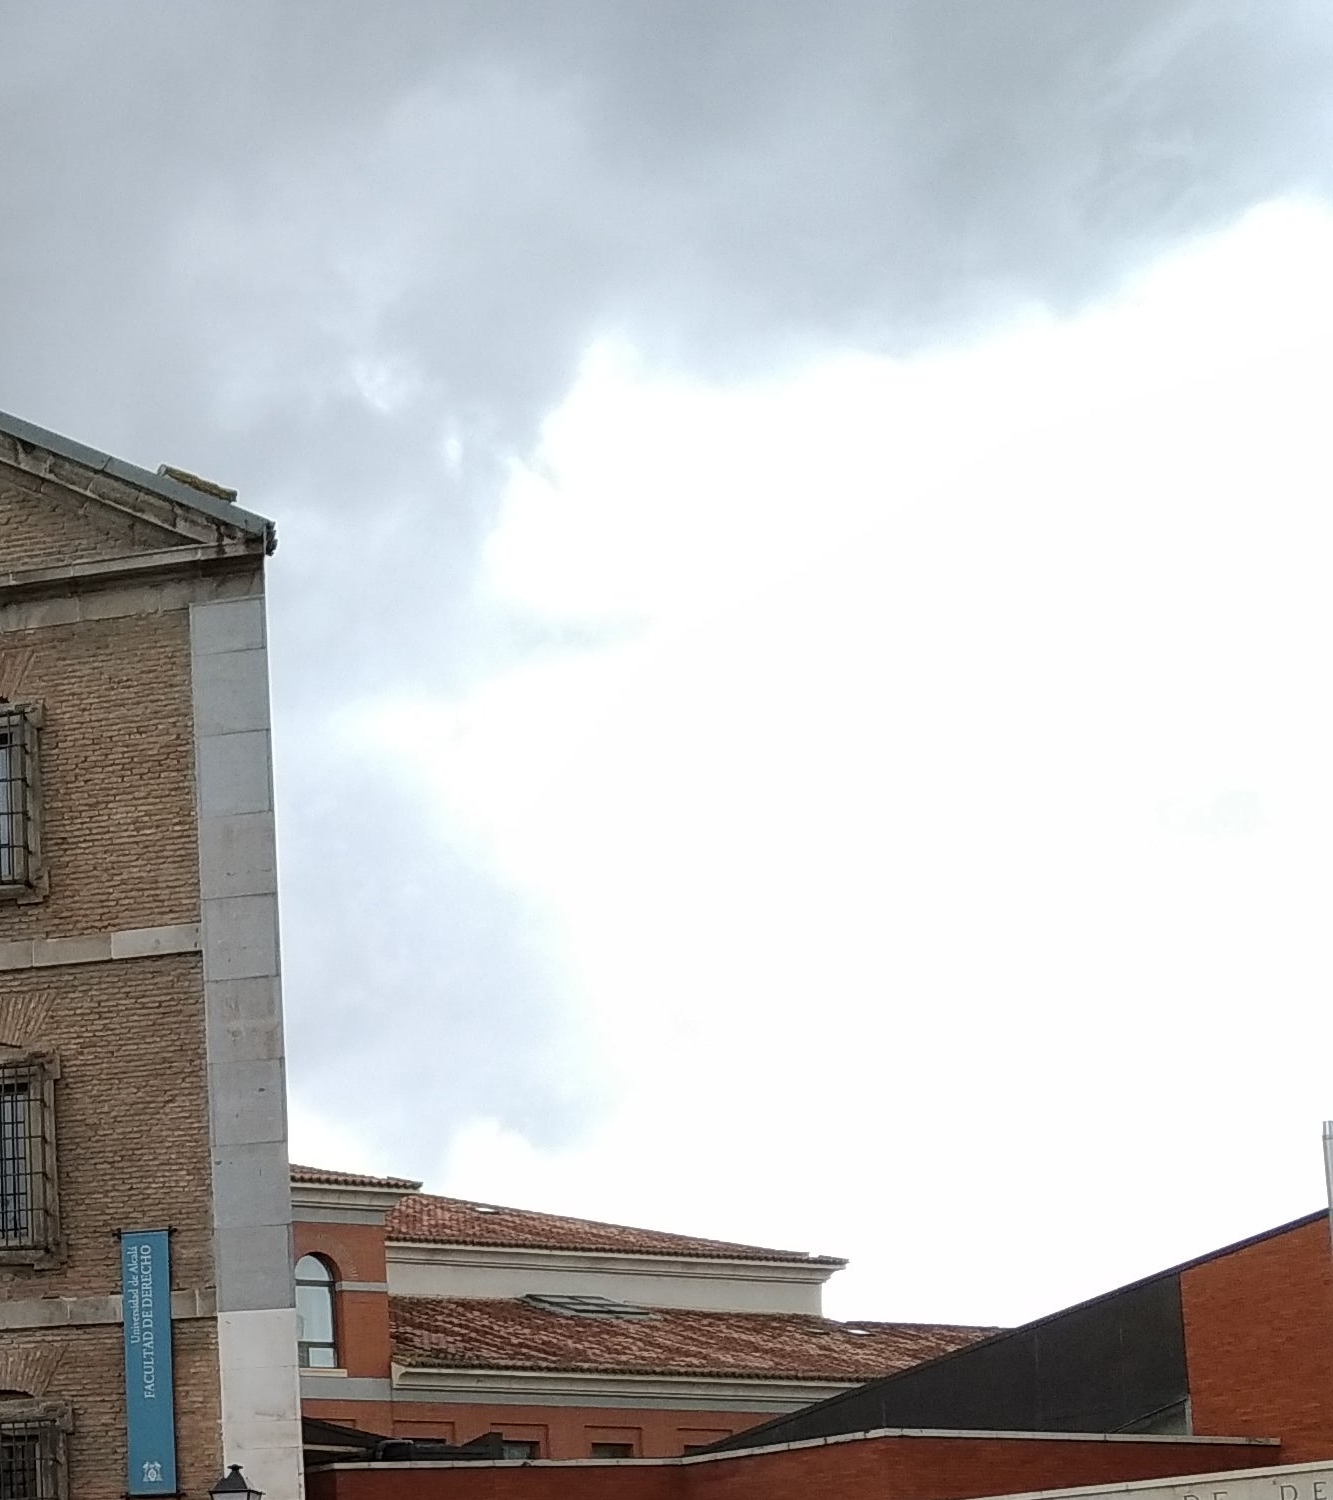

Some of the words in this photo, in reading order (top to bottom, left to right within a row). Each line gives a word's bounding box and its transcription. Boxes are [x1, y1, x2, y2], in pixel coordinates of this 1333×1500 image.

[127, 1274, 139, 1286] de
[140, 1244, 153, 1307] DERECHO
[128, 1287, 140, 1345] Universidad
[141, 1310, 154, 1327] DE
[142, 1331, 156, 1399] FACULTAD
